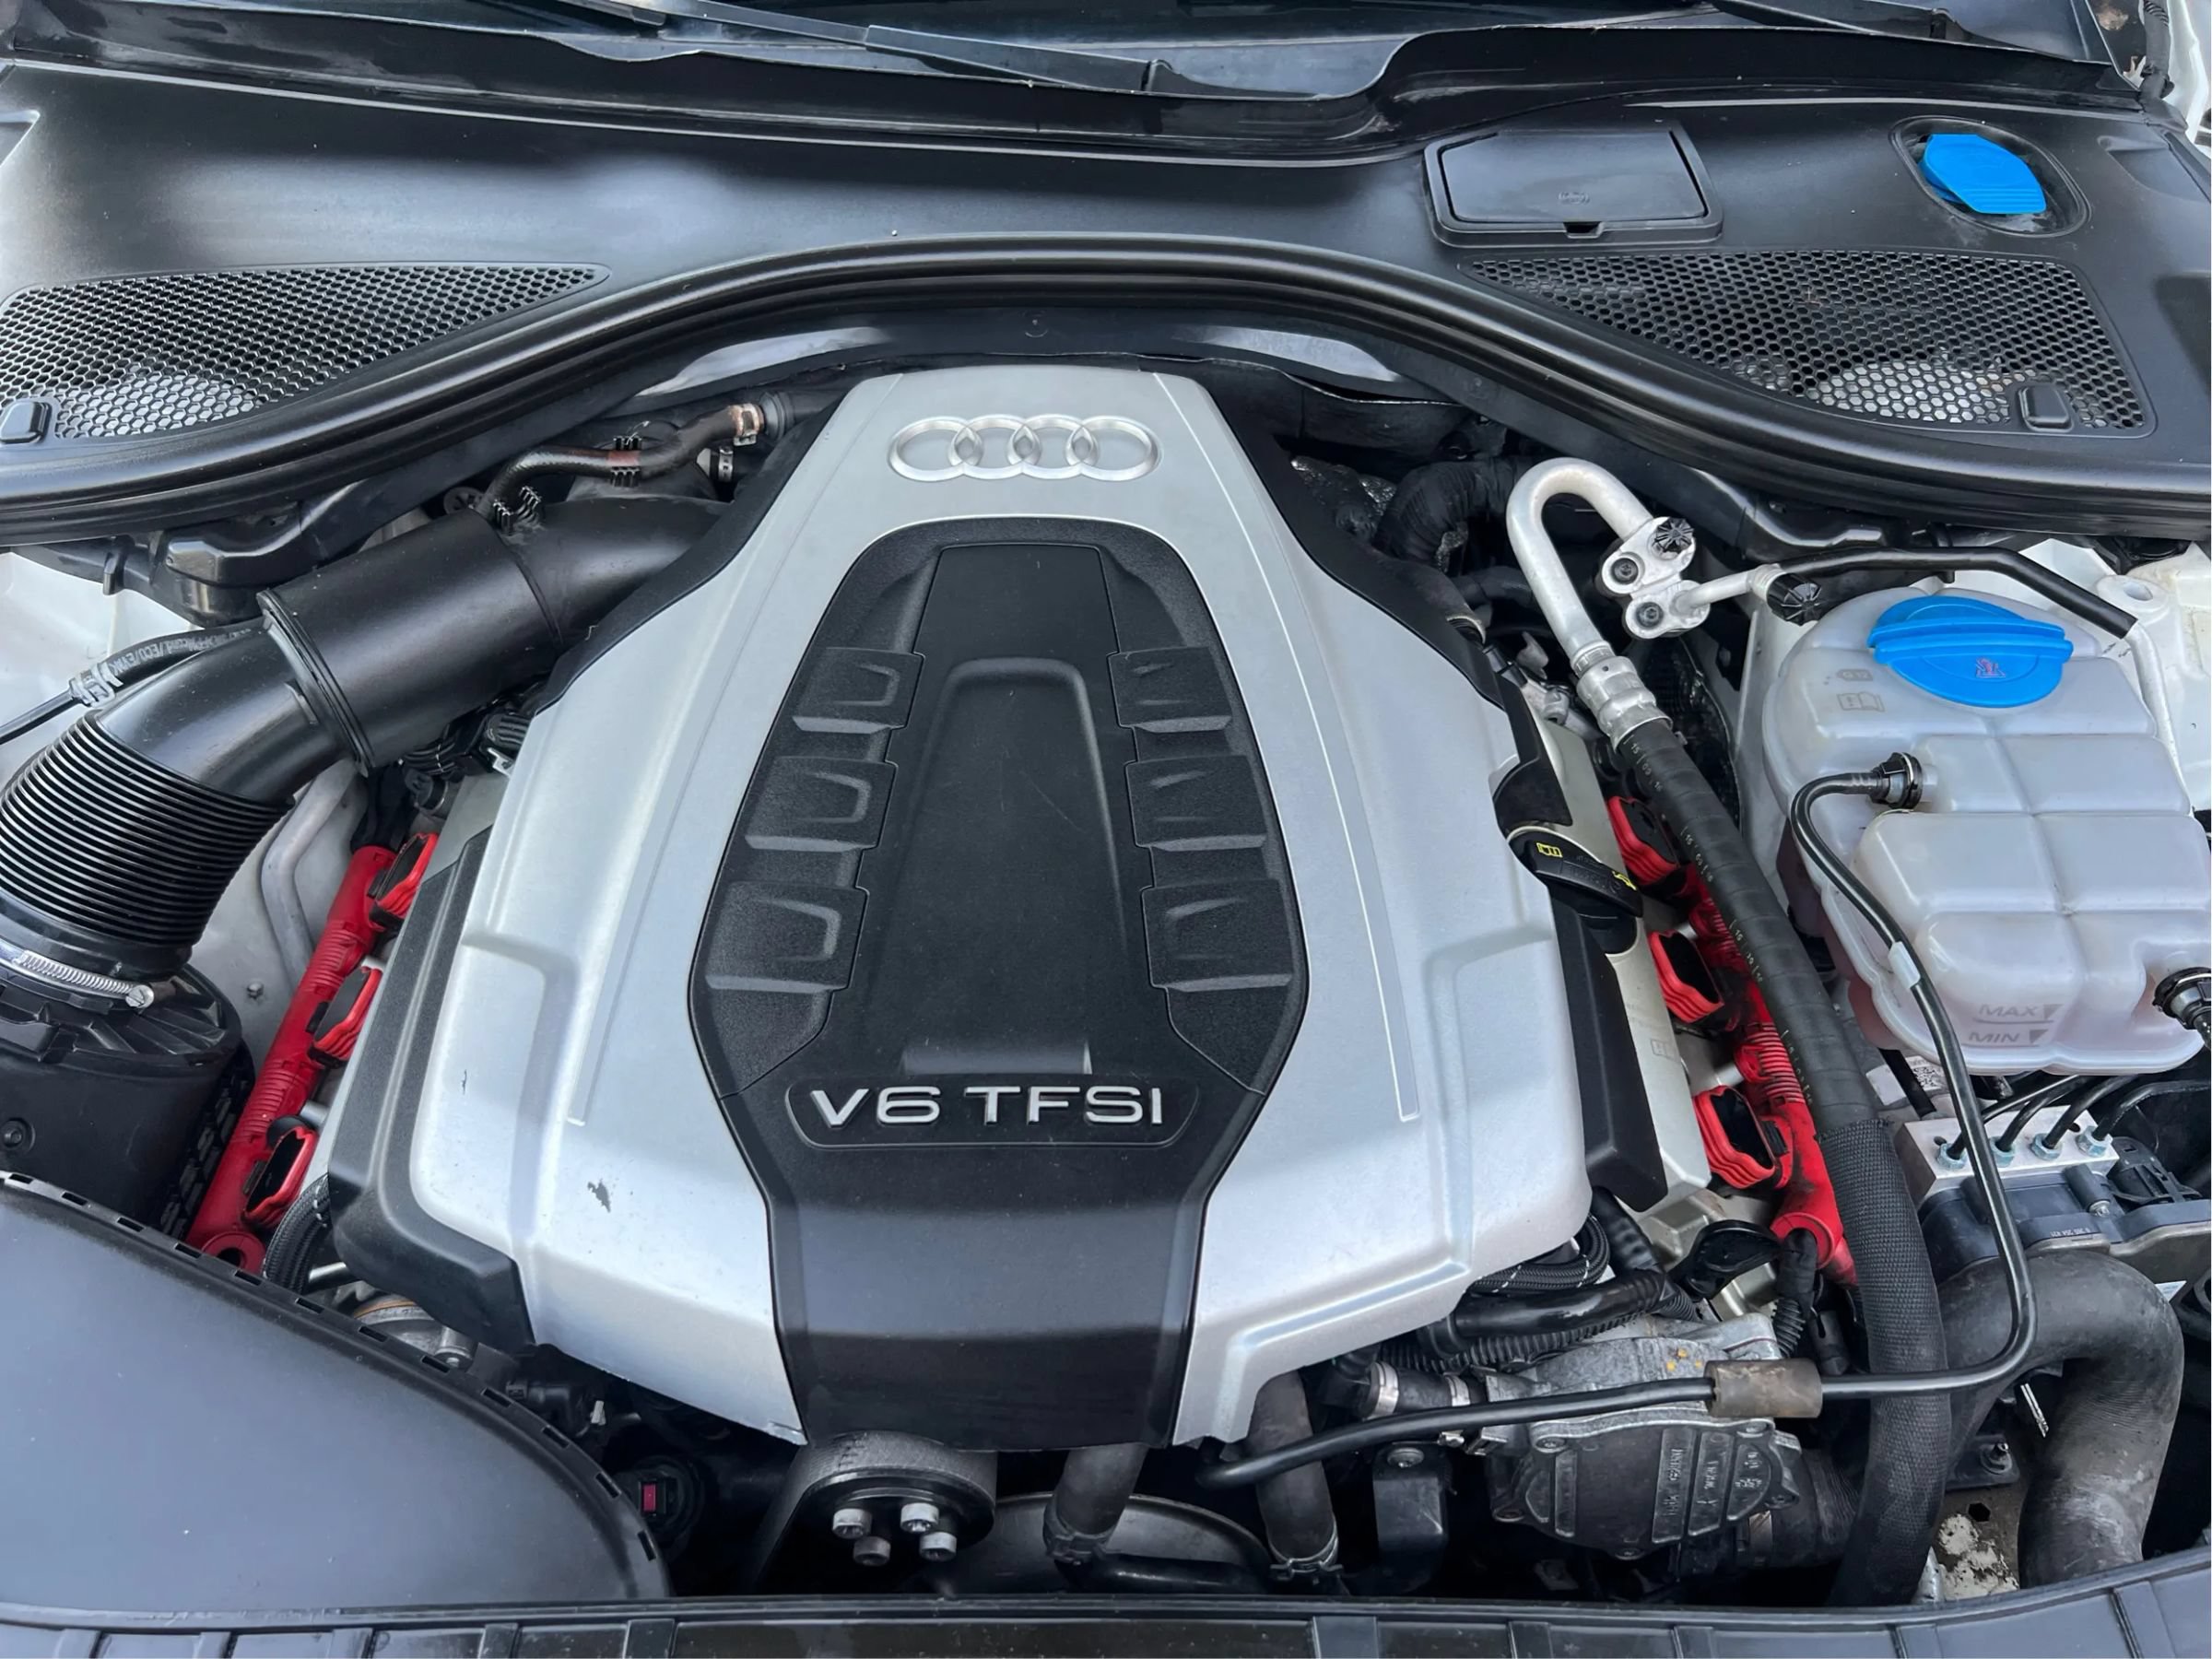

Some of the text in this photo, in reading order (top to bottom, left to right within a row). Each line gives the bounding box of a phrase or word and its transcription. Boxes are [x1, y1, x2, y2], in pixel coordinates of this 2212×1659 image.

[1979, 1003, 2039, 1018] MAX
[1968, 1031, 2020, 1043] MIN
[810, 1085, 1163, 1126] V6 TFSI
